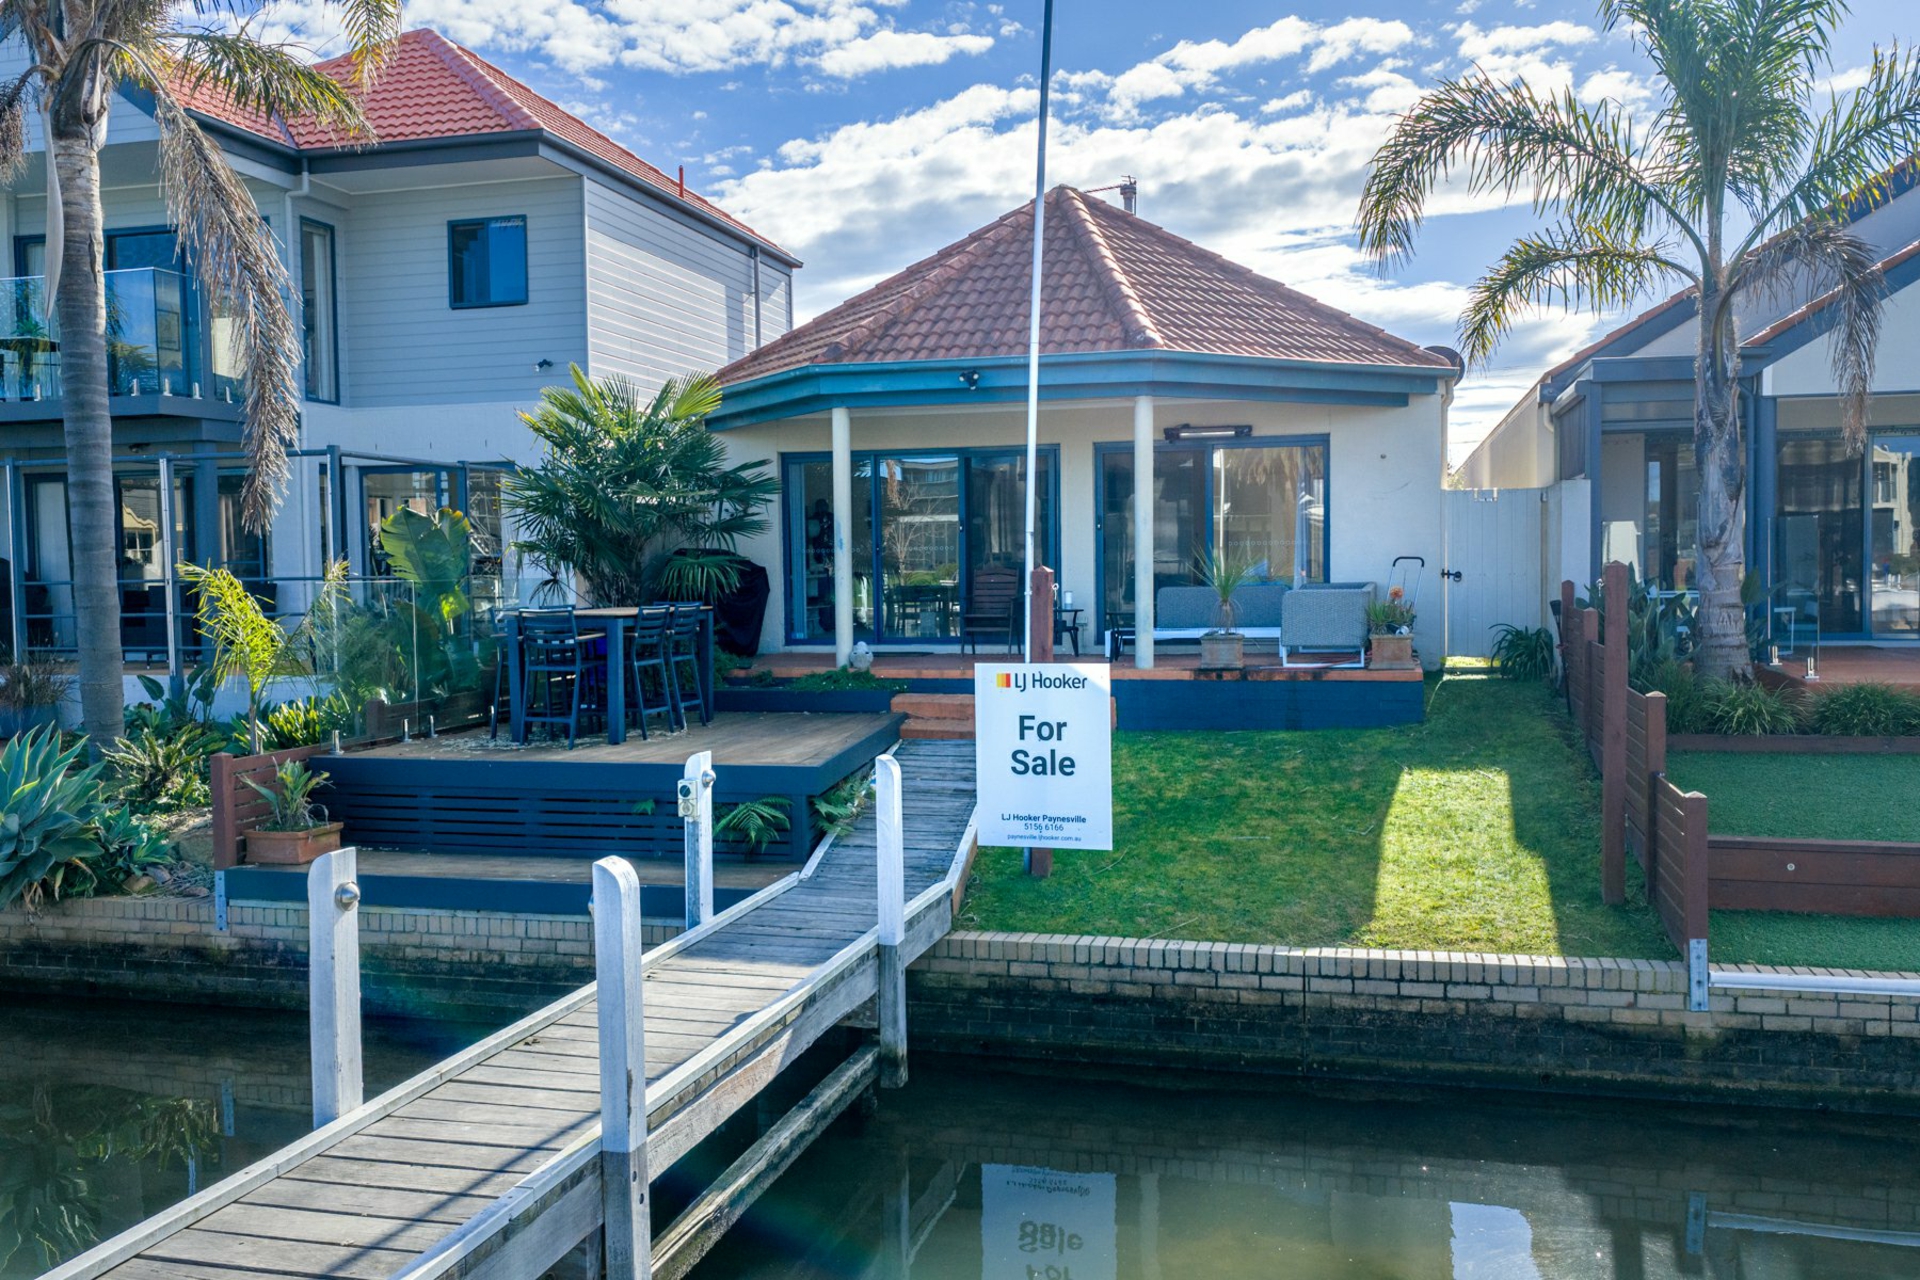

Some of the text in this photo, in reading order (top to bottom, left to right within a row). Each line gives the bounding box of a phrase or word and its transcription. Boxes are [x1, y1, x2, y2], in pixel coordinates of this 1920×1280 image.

[1014, 672, 1088, 693] LJ Hooker
[1018, 714, 1068, 742] For
[1010, 748, 1076, 777] Sale
[1001, 813, 1087, 824] LJ Hooker Paynesville
[1024, 822, 1065, 832] 5156 6166
